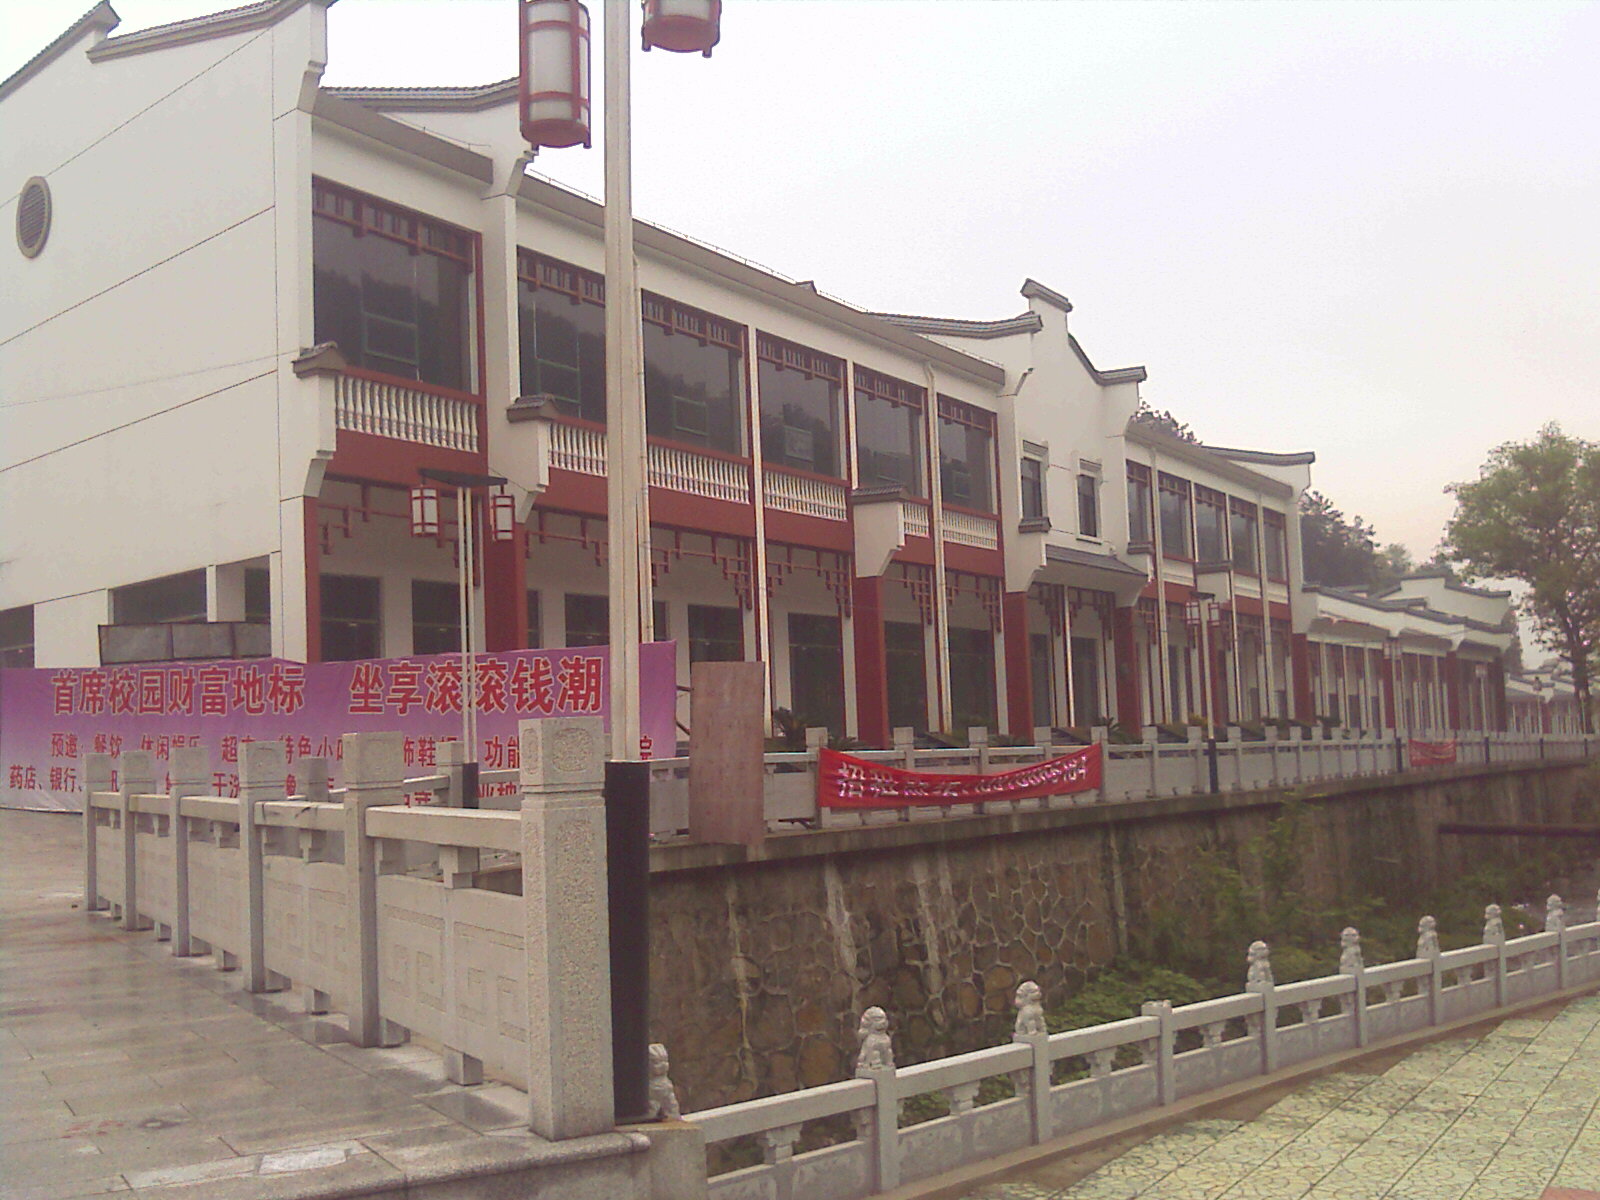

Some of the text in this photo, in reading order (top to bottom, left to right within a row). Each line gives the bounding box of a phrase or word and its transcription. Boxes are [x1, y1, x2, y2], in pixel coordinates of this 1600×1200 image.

[52, 655, 604, 716] 首席校园财富地标 坐享滚滚钱潮
